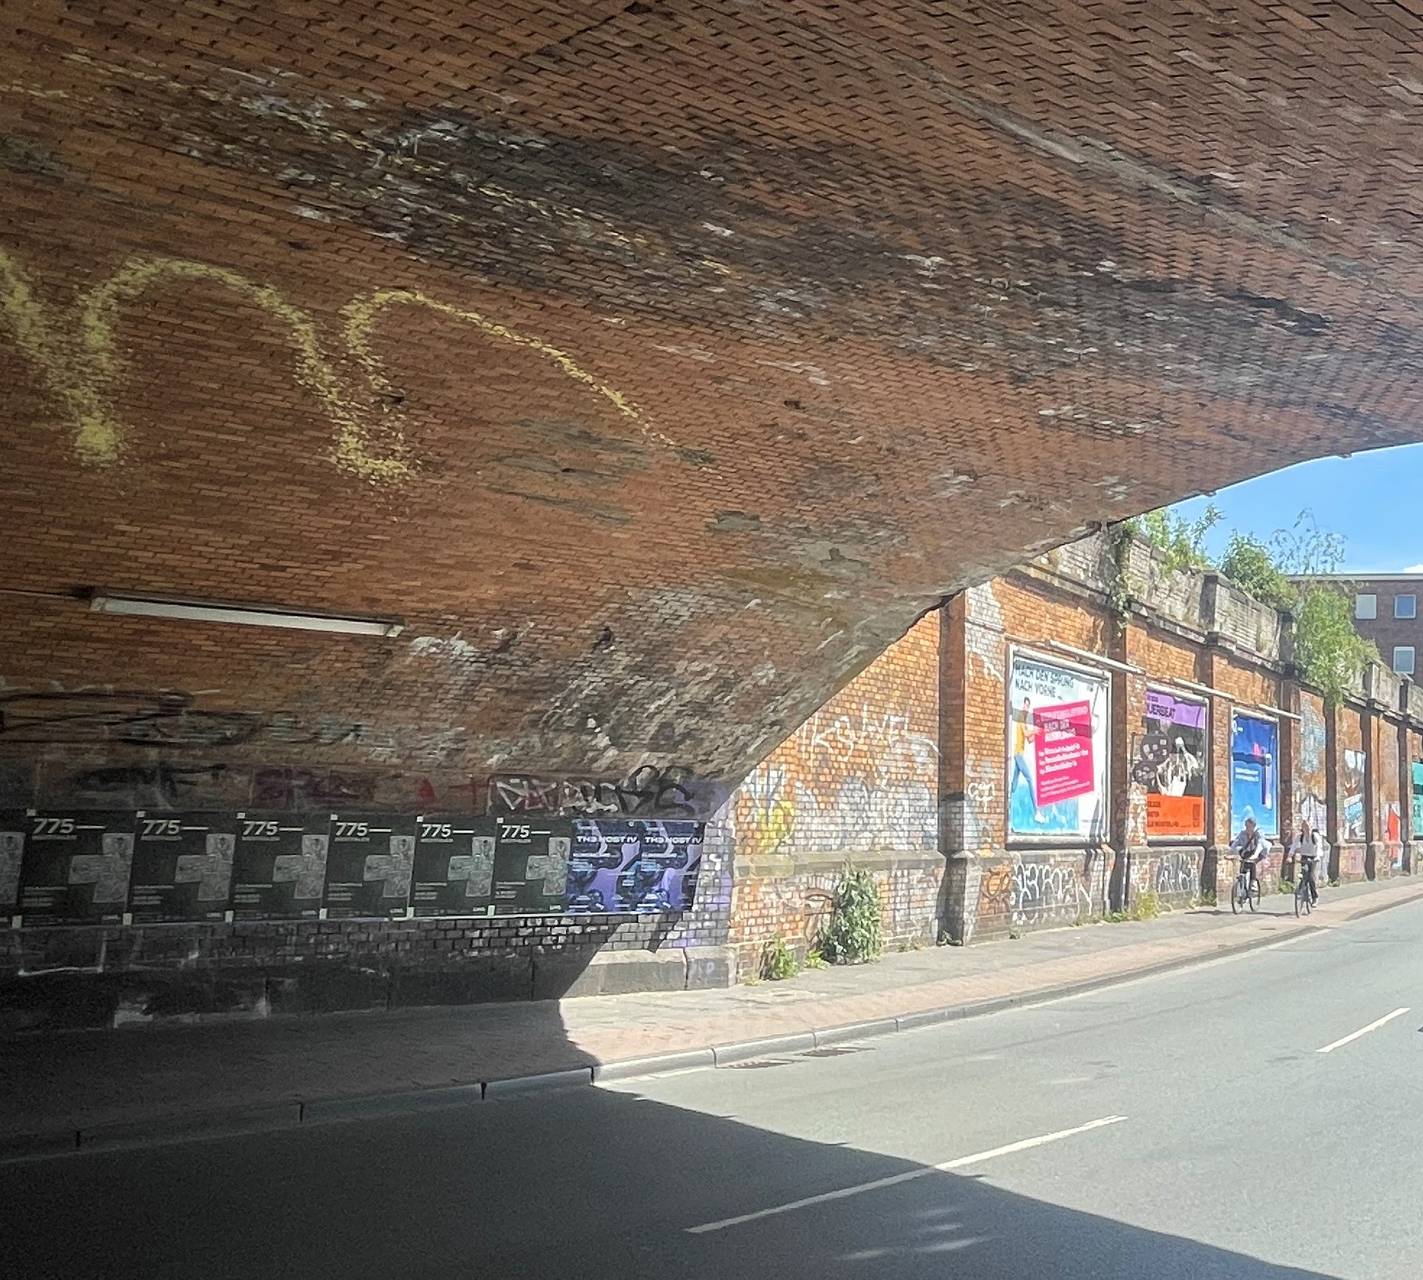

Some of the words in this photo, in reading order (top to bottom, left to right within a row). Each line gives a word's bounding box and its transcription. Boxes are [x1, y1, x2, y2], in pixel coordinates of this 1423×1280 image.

[33, 818, 76, 835] 775
[142, 819, 182, 835] 775
[242, 821, 280, 836] 775
[335, 822, 369, 837] 775
[421, 823, 452, 838] 775
[501, 825, 530, 839] 775
